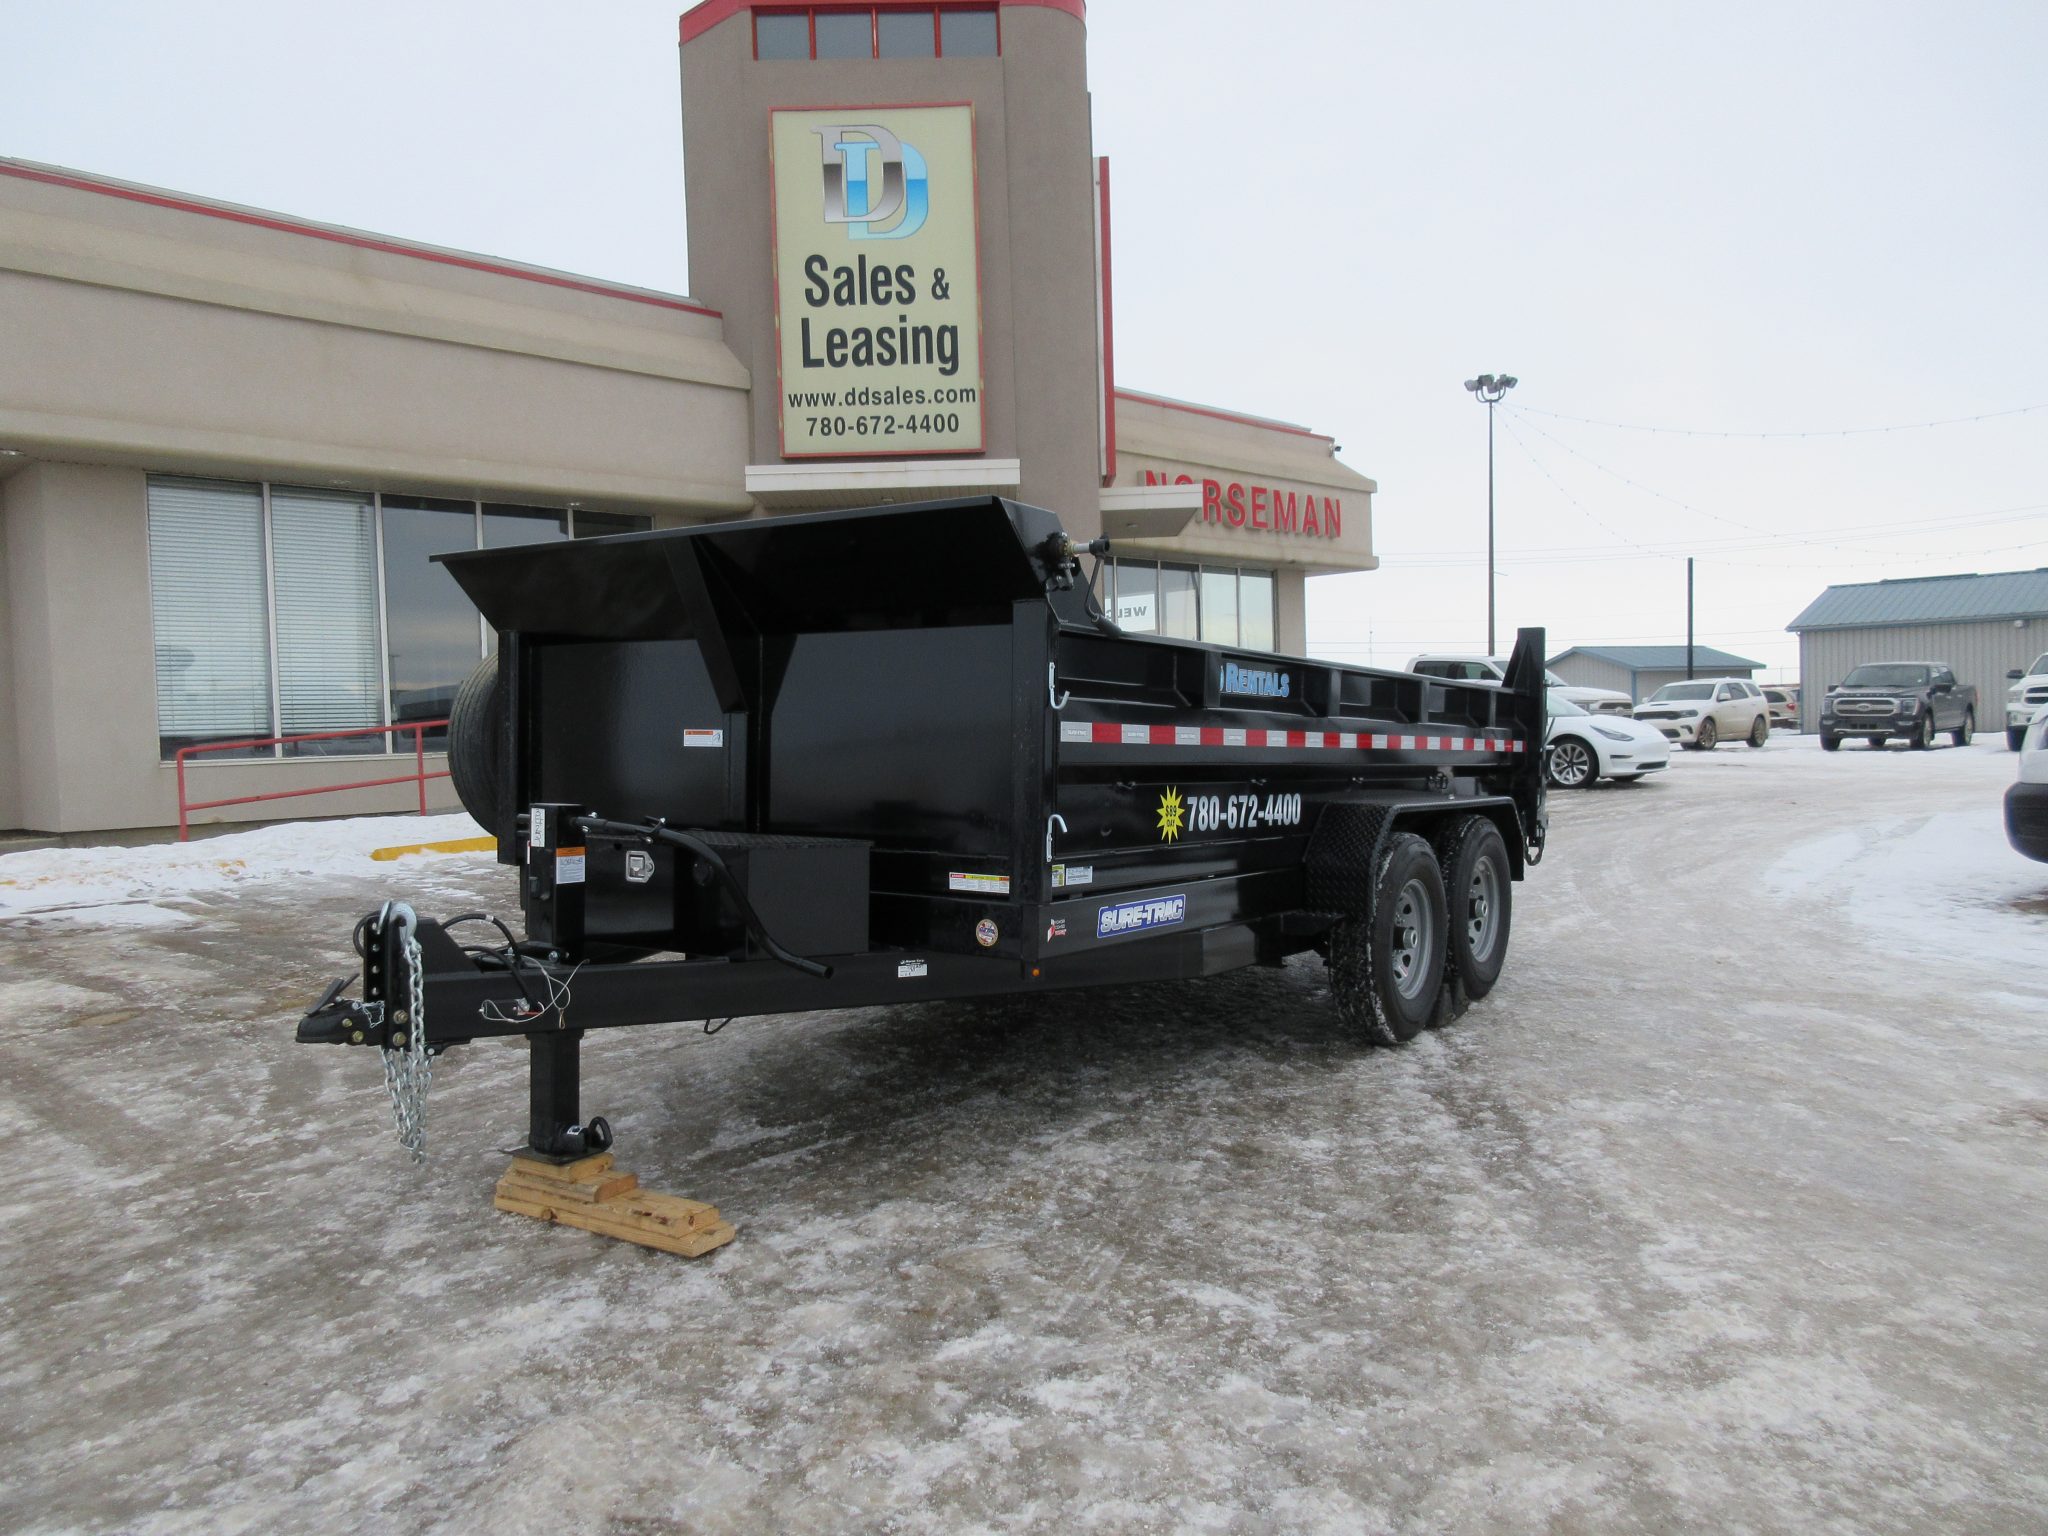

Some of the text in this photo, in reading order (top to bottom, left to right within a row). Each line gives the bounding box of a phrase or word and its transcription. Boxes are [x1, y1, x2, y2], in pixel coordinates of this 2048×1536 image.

[804, 254, 950, 307] Sales &
[800, 314, 959, 376] Leasing
[788, 386, 976, 408] www.ddsales.com
[806, 413, 959, 436] 780-672-4400
[1145, 470, 1341, 537] RSEMAN
[1226, 663, 1289, 697] RENTALS
[1187, 793, 1301, 832] 780-672-4400
[1100, 899, 1183, 933] SURE-TRAC
